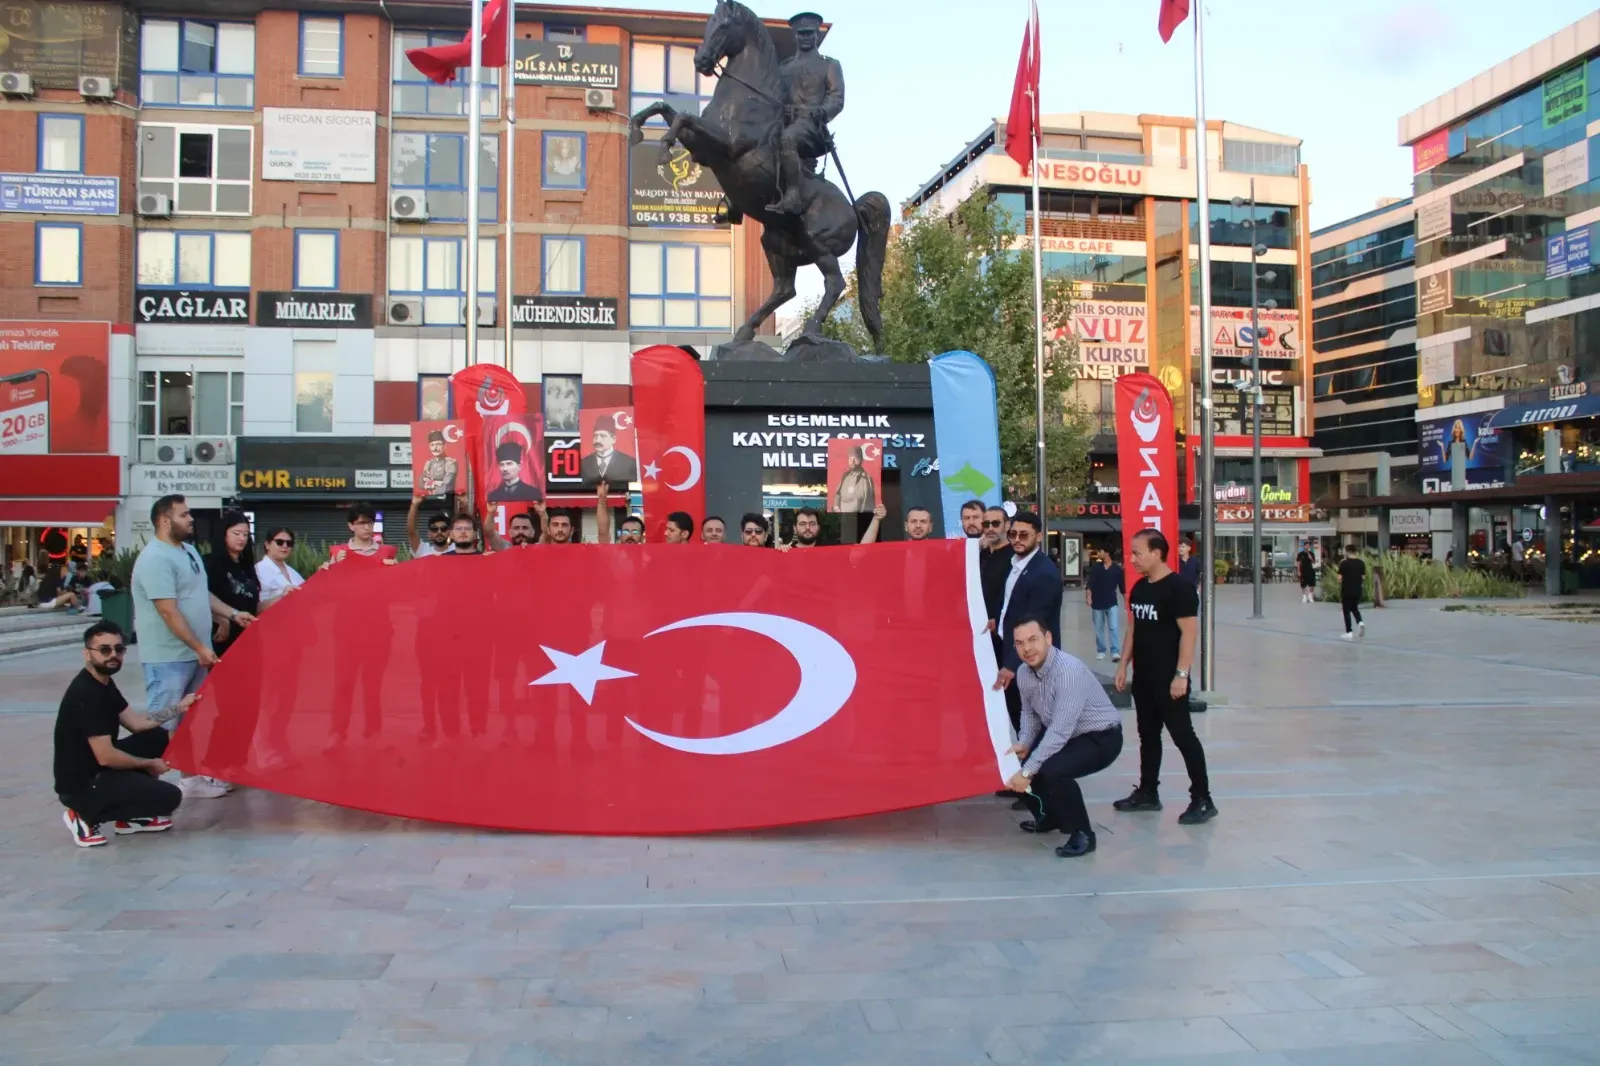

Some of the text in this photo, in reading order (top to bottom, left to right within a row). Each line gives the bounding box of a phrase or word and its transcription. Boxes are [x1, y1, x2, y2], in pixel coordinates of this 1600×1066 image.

[278, 114, 372, 126] HERCAN SİGORTA
[24, 184, 115, 200] TÜRKAN ŞANS
[634, 189, 668, 198] MELODY
[695, 191, 725, 199] BEAUTY
[636, 212, 664, 221] 0541
[669, 213, 690, 222] 938
[694, 214, 708, 223] 52
[1079, 241, 1114, 252] CAFE
[140, 291, 248, 322] ÇAĞLAR
[276, 298, 356, 321] MİMARLIK
[512, 299, 615, 325] MÜHENDİSLİK
[1098, 305, 1145, 317] SORUN
[25, 327, 59, 338] Yönelik
[1042, 317, 1145, 343] AVUZ
[11, 340, 56, 350] Teklifler
[1086, 347, 1146, 363] KURSU
[1211, 369, 1283, 385] CLINIC
[1521, 404, 1578, 422] EATFORD
[2, 413, 45, 439] 20 GB
[732, 432, 829, 447] KAYITSIZ
[239, 470, 291, 488] CMR
[1214, 484, 1246, 501] eydan
[1223, 506, 1304, 520] KÖTECİ
